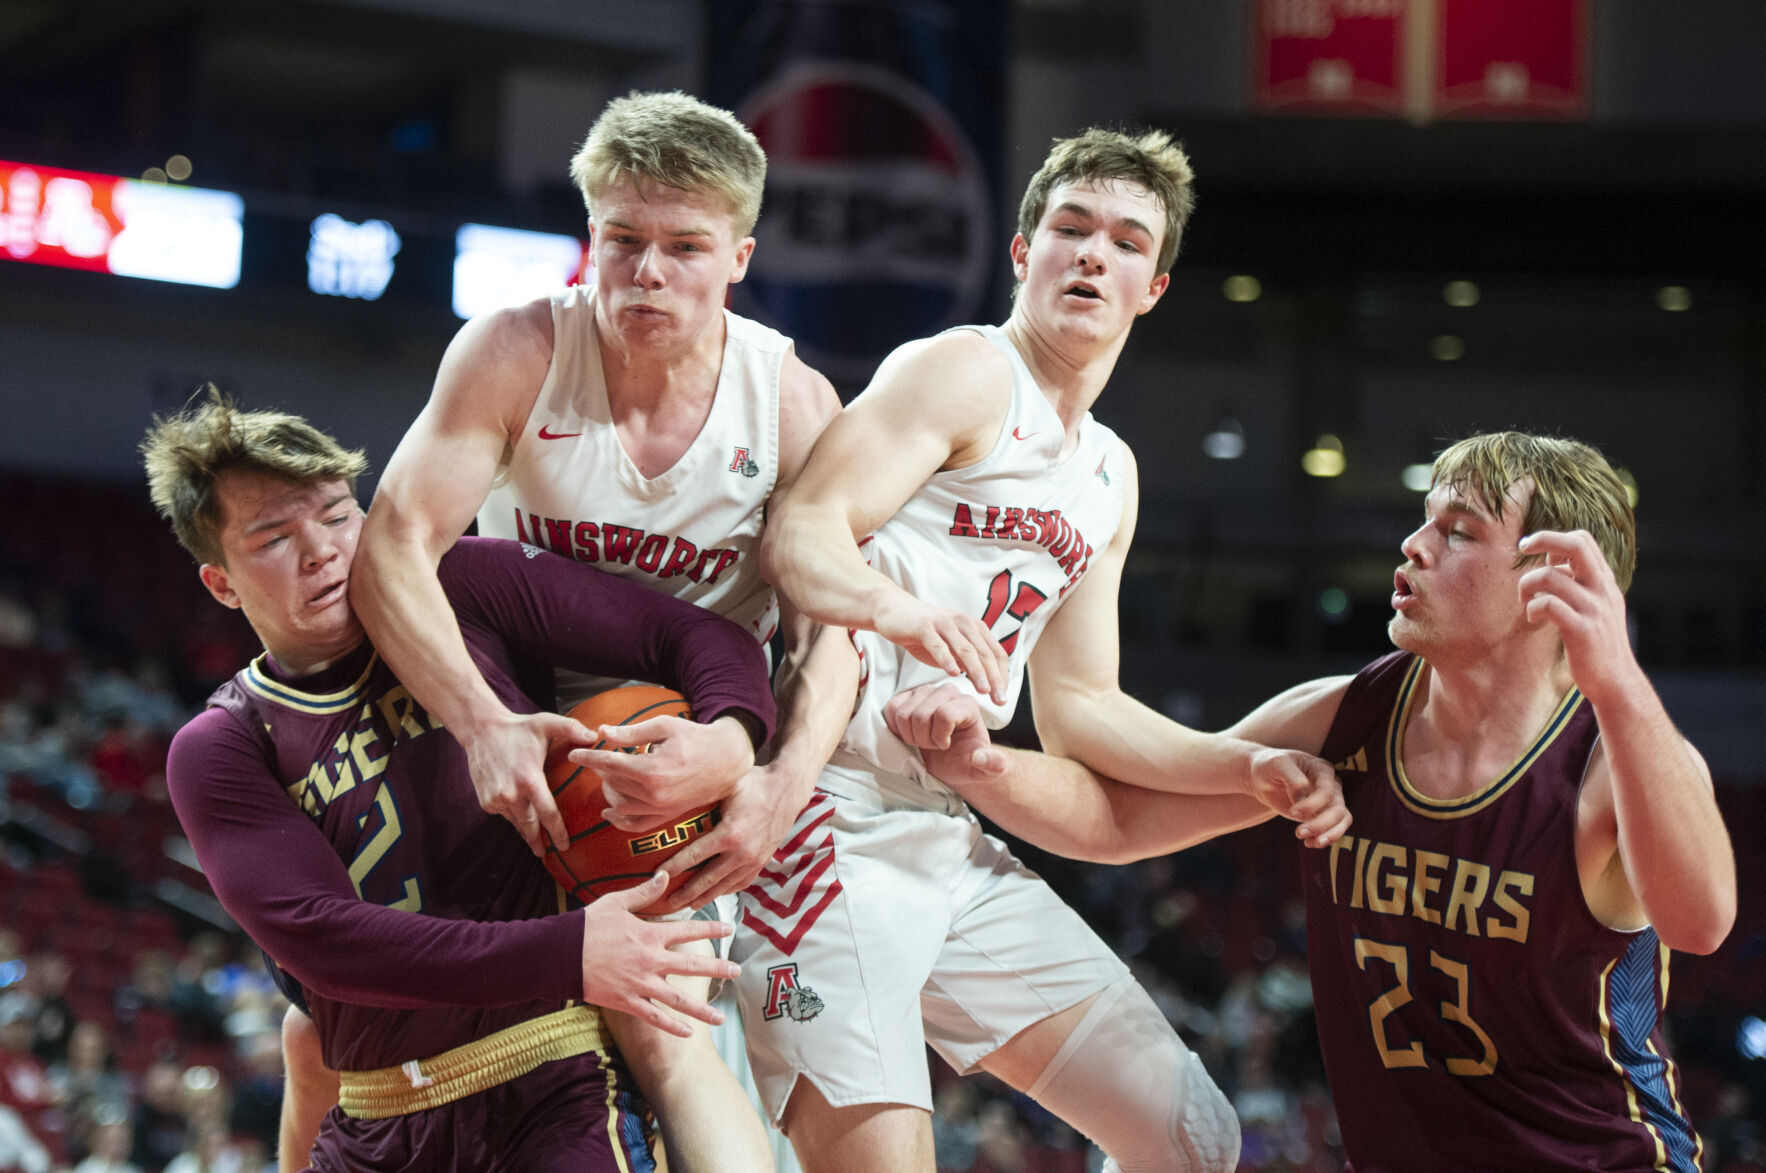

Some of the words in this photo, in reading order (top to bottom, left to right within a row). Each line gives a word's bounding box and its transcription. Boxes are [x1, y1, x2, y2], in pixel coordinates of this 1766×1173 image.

[347, 778, 424, 914] 2
[1329, 834, 1536, 945] TIGERS
[763, 963, 802, 1022] A
[1353, 936, 1500, 1077] 23
